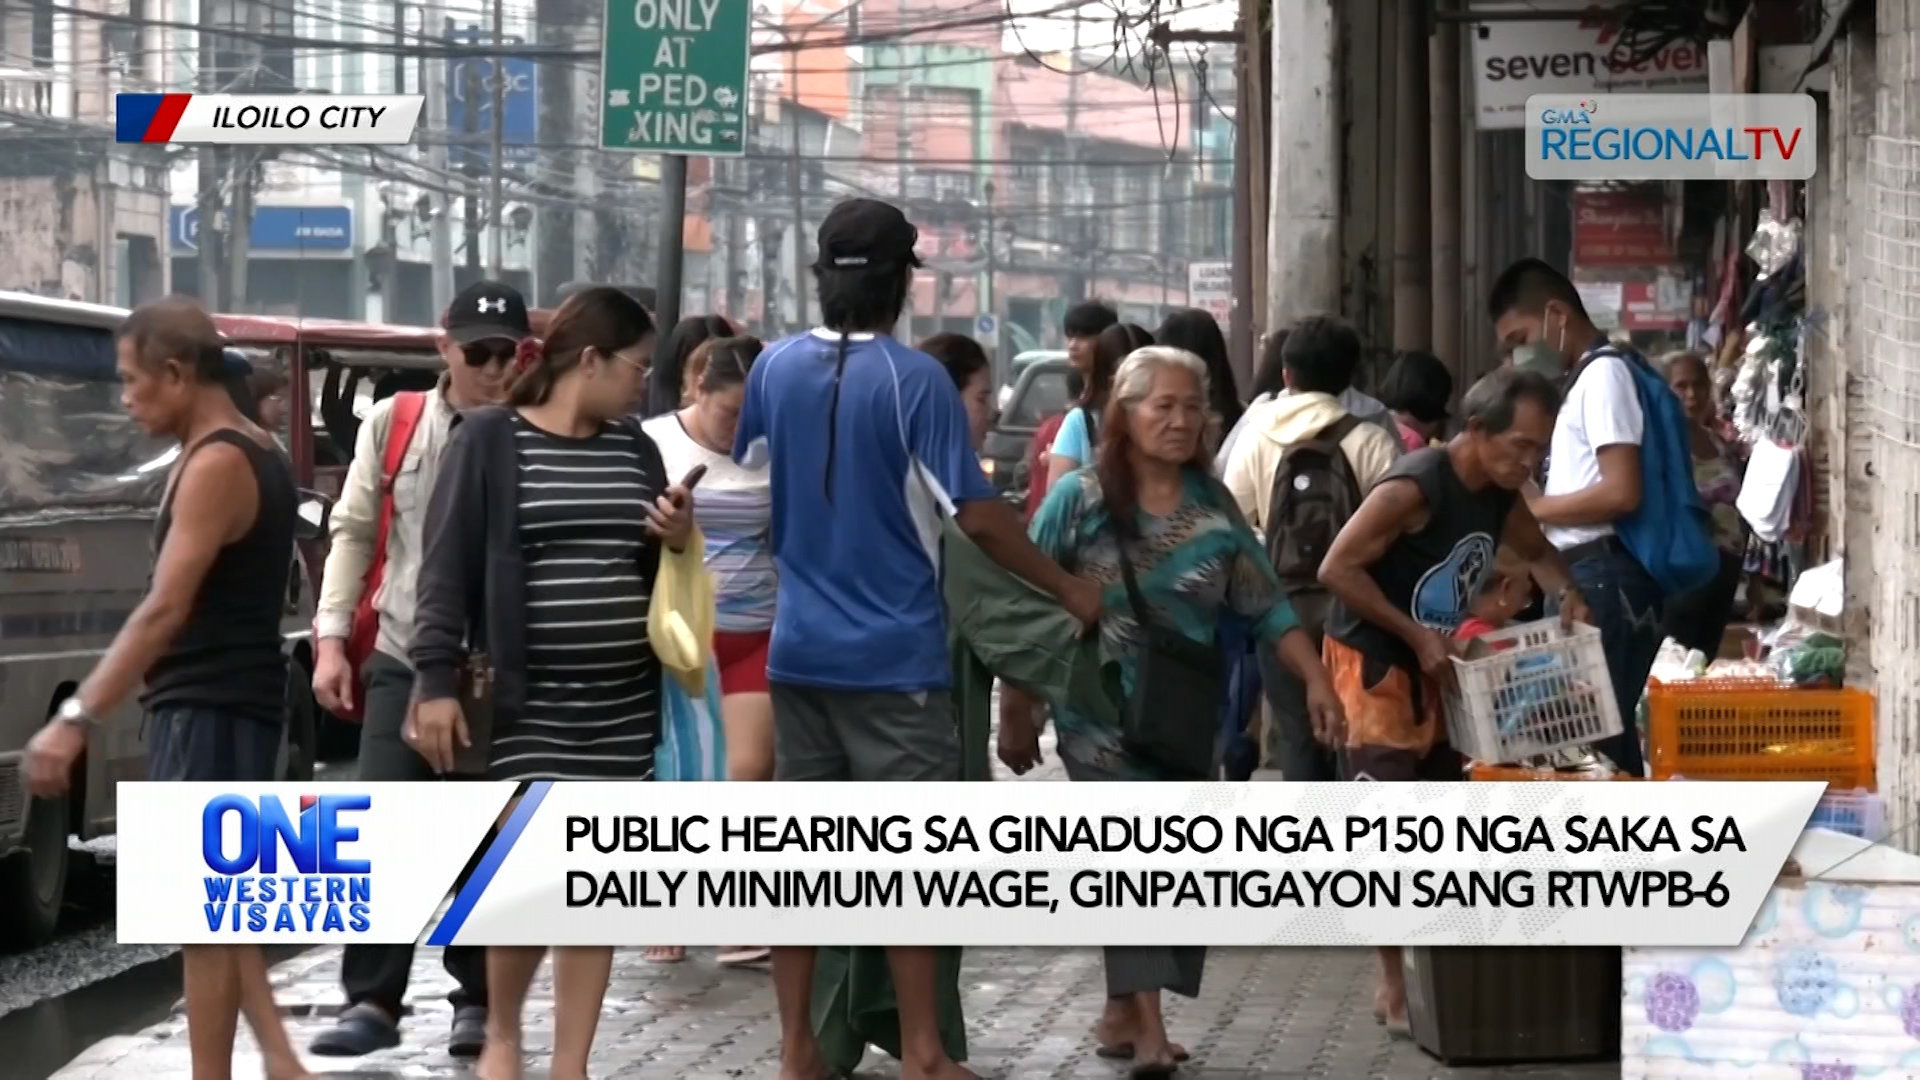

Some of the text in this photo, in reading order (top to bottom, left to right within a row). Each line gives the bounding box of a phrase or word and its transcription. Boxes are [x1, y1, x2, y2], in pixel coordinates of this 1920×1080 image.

[634, 0, 720, 31] ONLY
[653, 36, 695, 68] AT
[1486, 51, 1595, 81] seven
[638, 73, 708, 107] PED
[632, 110, 713, 144] XING
